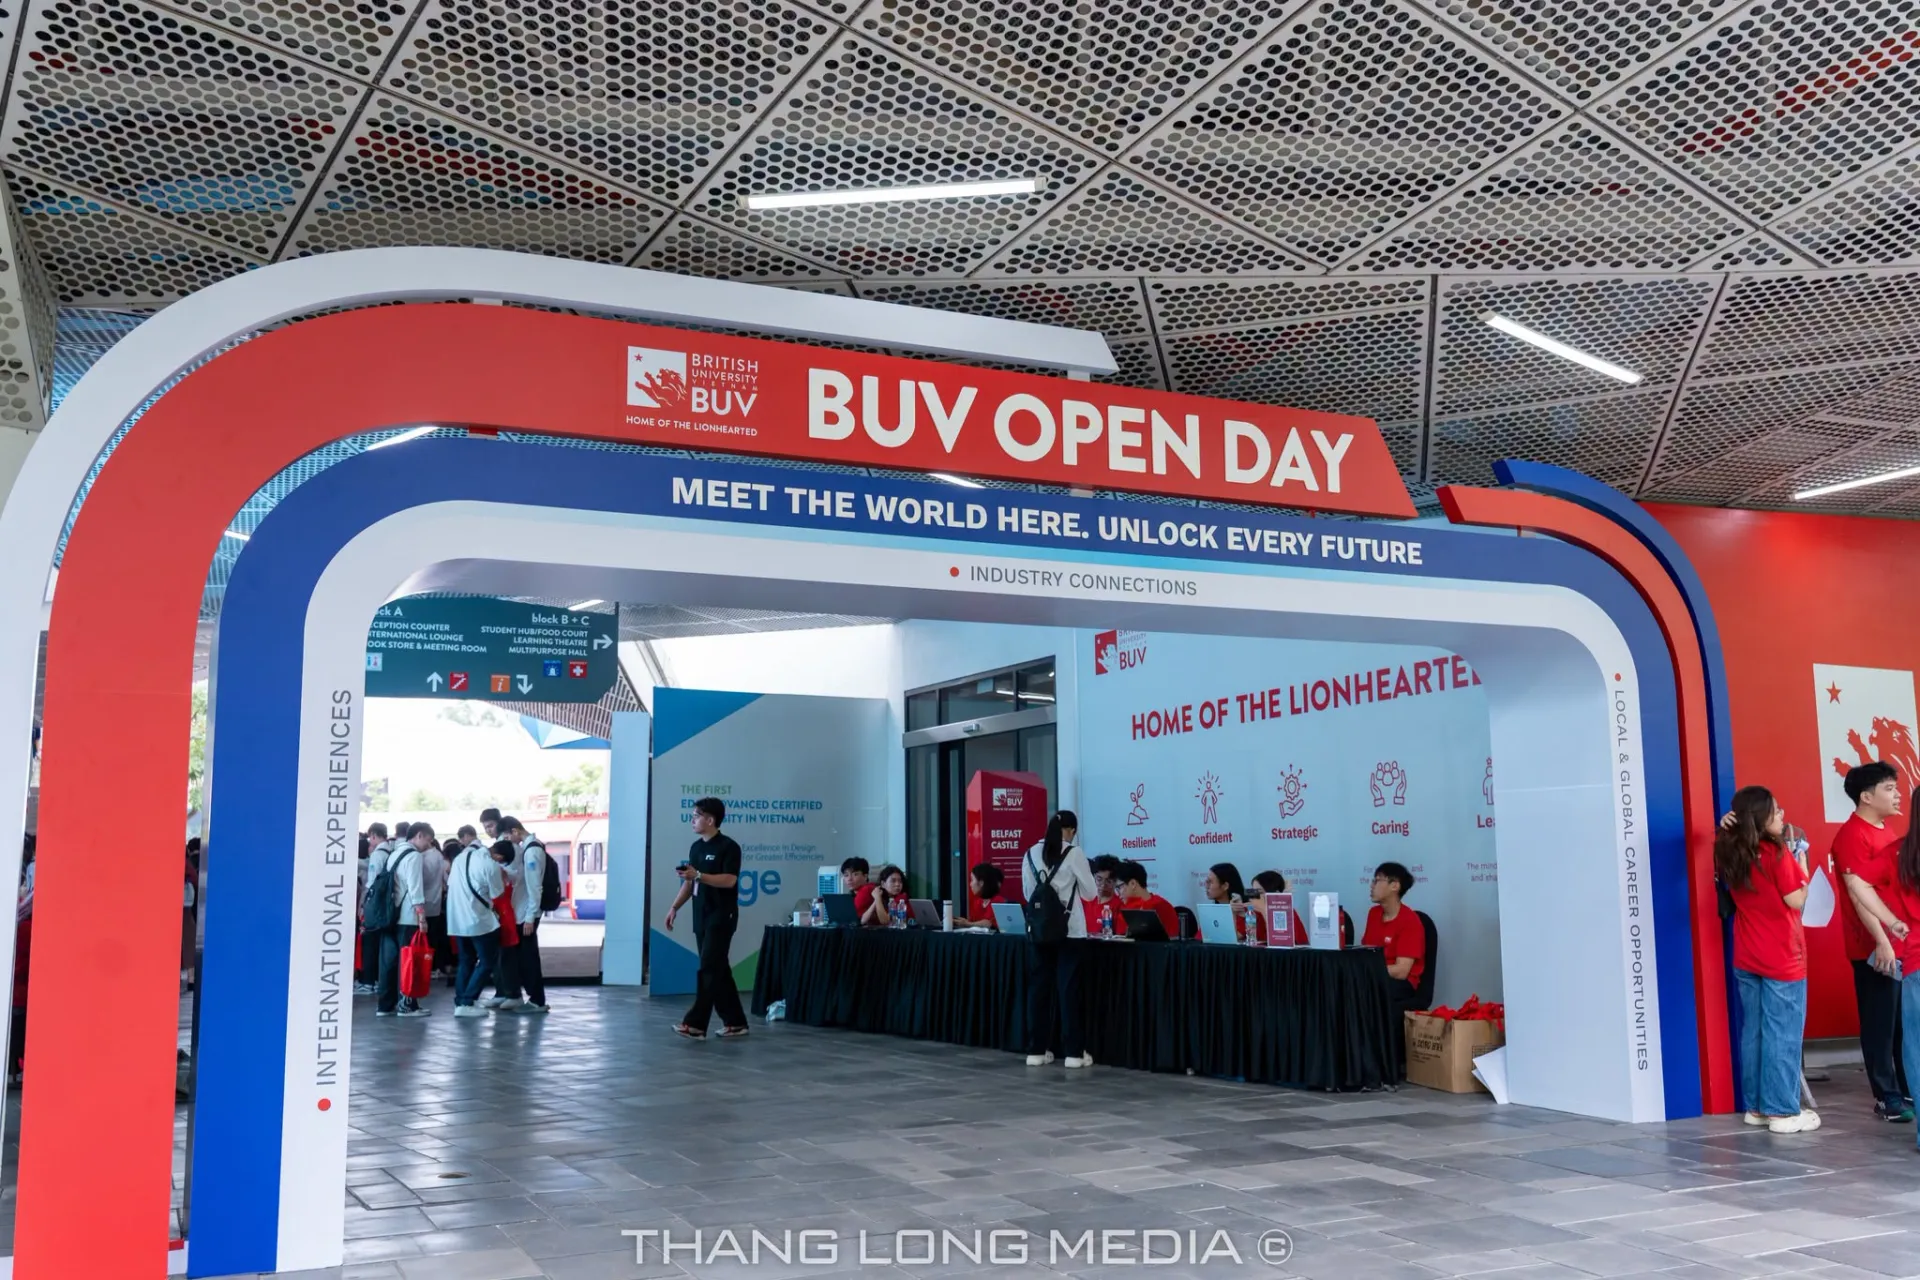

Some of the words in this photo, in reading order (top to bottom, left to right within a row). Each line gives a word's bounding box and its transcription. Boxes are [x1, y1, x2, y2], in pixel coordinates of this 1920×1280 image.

[692, 353, 758, 373] BRITISH
[692, 369, 758, 384] UNIVERSITY
[691, 387, 758, 418] BUV
[626, 415, 655, 427] HOME
[658, 418, 671, 428] OF
[673, 420, 691, 430] THE
[694, 422, 758, 436] LIONHEARTED
[808, 367, 979, 454] BUV
[993, 393, 1201, 480] OPEN
[1224, 419, 1355, 494] DAY
[672, 476, 775, 511] MEET
[784, 487, 856, 519] THE
[864, 494, 988, 530] WORLD
[997, 506, 1090, 539] HERE.
[1098, 516, 1219, 549] UNLOCK
[1227, 526, 1314, 557] EVERY
[1321, 535, 1424, 566] FUTURE
[970, 565, 1064, 587] INDUSTRY
[1069, 572, 1198, 596] CONNECTIONS
[394, 606, 403, 616] A
[531, 612, 559, 624] block
[561, 614, 569, 625] B
[581, 615, 590, 626] C
[369, 621, 409, 630] CEPTION
[410, 622, 450, 632] COUNTER
[480, 625, 517, 634] STUDENT
[518, 627, 561, 637] HUB/FOOD
[561, 629, 589, 638] COURT
[429, 633, 464, 642] LOUNGE
[513, 636, 554, 646] LEARNING
[554, 638, 588, 647] THEATRE
[367, 640, 387, 648] OOK
[388, 641, 415, 650] STORE
[423, 643, 460, 652] MEETING
[461, 645, 487, 653] ROOM
[508, 645, 567, 656] MULTIPURPOSE
[568, 648, 588, 656] HALL
[1119, 646, 1147, 670] BUV
[1131, 704, 1193, 741] HOME
[1199, 697, 1229, 730] OF
[1235, 688, 1282, 724] THE
[1289, 654, 1482, 716] LIONHEARTE
[1614, 689, 1628, 748] LOCAL
[1618, 752, 1629, 764] &
[325, 689, 352, 865] EXPERIENCES
[681, 784, 701, 795] THE
[704, 785, 732, 796] FIRST
[771, 800, 823, 810] CERTIFIED
[1620, 769, 1634, 841] GLOBAL
[745, 814, 758, 824] IN
[759, 814, 805, 824] VIETNAM
[1477, 814, 1496, 828] Le
[991, 829, 1022, 838] BELFAST
[1271, 825, 1318, 841] Strategic
[1371, 820, 1410, 837] Caring
[991, 841, 1019, 849] CASTLE
[1122, 836, 1157, 849] Resilient
[1188, 832, 1233, 845] Confident
[1624, 846, 1640, 919] CAREER
[316, 874, 345, 1086] INTERNATIONAL
[1629, 924, 1648, 1071] OPPORTUNITIES
